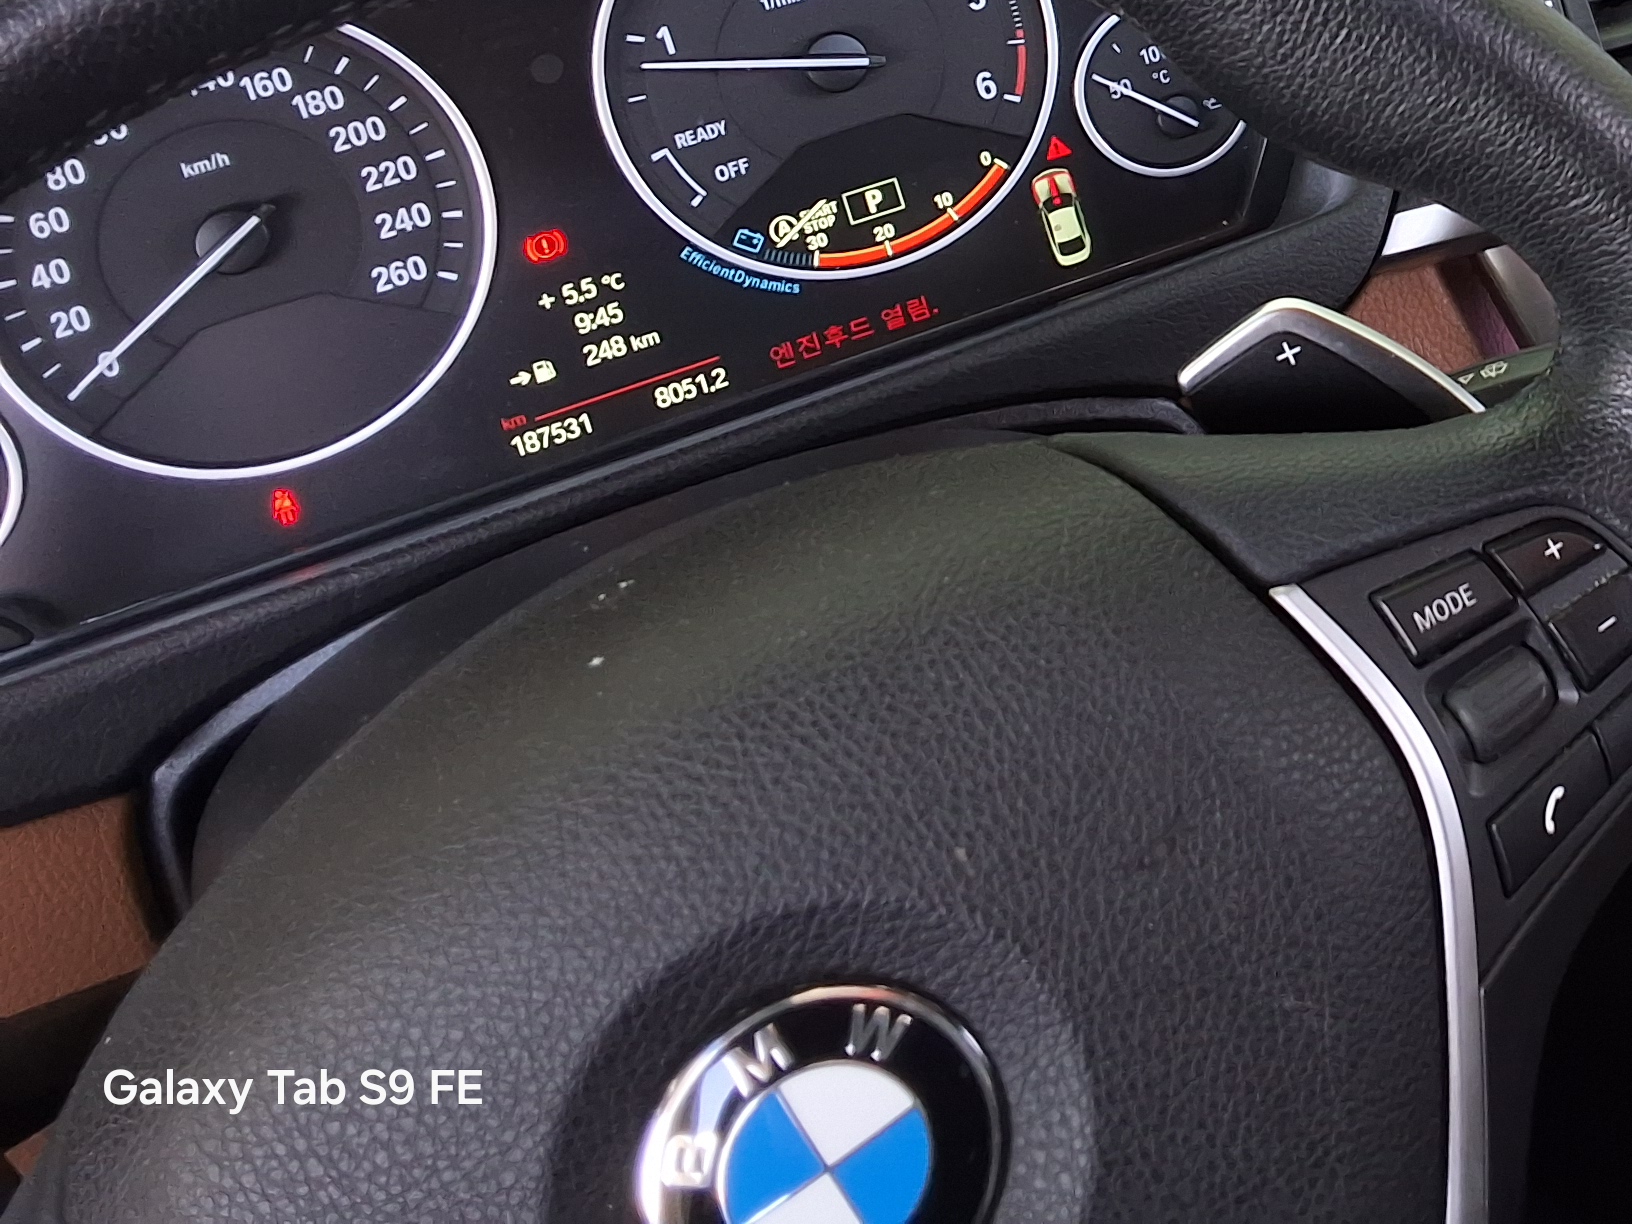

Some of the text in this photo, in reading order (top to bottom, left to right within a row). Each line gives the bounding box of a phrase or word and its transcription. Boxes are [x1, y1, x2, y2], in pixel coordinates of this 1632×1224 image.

[656, 25, 677, 55] 1
[1139, 45, 1167, 65] 10
[239, 67, 293, 101] 160
[975, 71, 998, 100] 6
[1109, 78, 1133, 100] 50
[291, 85, 345, 120] 180
[329, 116, 387, 153] 200
[674, 120, 727, 149] READY
[46, 158, 86, 191] 80
[180, 152, 231, 179] km/h
[360, 155, 418, 193] 220
[714, 157, 749, 183] OFF
[979, 151, 992, 166] 0
[864, 188, 884, 214] P
[934, 191, 954, 209] 10
[28, 206, 70, 239] 60
[374, 202, 432, 240] 240
[803, 215, 837, 235] STOP
[873, 223, 896, 243] 20
[807, 232, 829, 251] 30
[31, 258, 71, 289] 40
[370, 255, 428, 294] 260
[679, 245, 801, 294] EfficientDynamics
[561, 276, 598, 306] 5.5
[50, 305, 91, 339] 20
[573, 301, 625, 335] 9:45
[582, 331, 661, 367] 248 km
[769, 317, 875, 369] 엔진후드
[97, 351, 119, 377] 0
[653, 367, 730, 409] 8051.2
[500, 415, 527, 430] km
[510, 412, 594, 457] 187531
[1412, 582, 1477, 634] MODE
[660, 1002, 913, 1189] BMW
